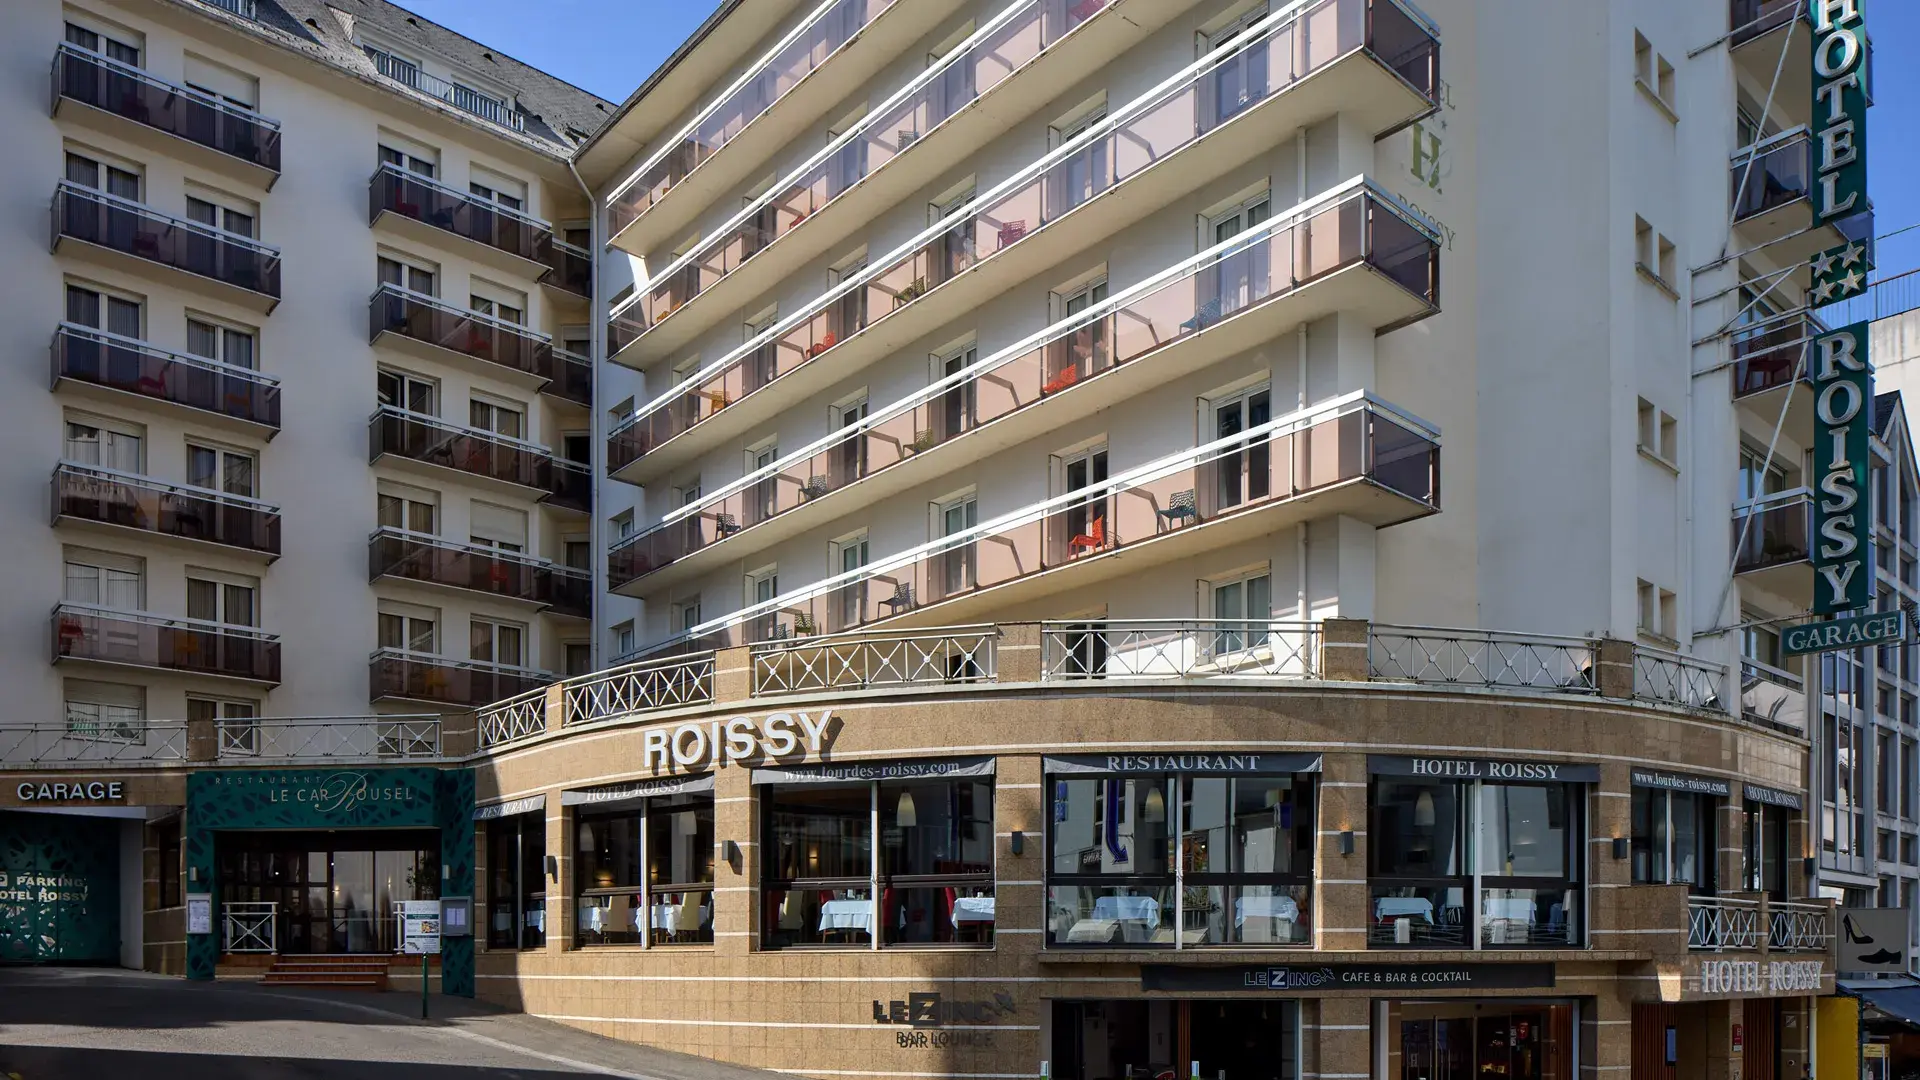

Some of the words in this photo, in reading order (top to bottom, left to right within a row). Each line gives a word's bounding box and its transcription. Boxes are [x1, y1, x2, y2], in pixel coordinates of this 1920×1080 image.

[1817, 331, 1865, 606] ROISSY
[1789, 615, 1899, 651] GARAGE
[644, 710, 833, 768] ROISSY
[784, 762, 960, 780] www.lourdes-roissy.com
[1106, 755, 1261, 772] RESTAURANT
[1411, 758, 1482, 777] HOTEL
[1488, 761, 1560, 780] ROISSY
[17, 781, 122, 801] GARAGE
[215, 776, 322, 785] RESTAURANT
[586, 784, 631, 803] HOTEL
[635, 777, 687, 796] ROISSY
[1634, 772, 1728, 793] www.lourdes-roissy.com
[271, 789, 289, 802] LE
[1749, 785, 1773, 802] HOTEL
[1774, 791, 1799, 808] ROISSY
[481, 797, 537, 819] RESTAURANT
[16, 876, 84, 887] PARKING
[0, 890, 34, 901] OTEL
[38, 891, 89, 902] ROISSY
[1342, 972, 1370, 982] CAFE
[1374, 972, 1381, 982] &
[1385, 972, 1407, 982] BAR
[1410, 972, 1417, 982] &
[1422, 971, 1472, 982] COCKTAIL
[1703, 960, 1761, 993] HOTEL
[1770, 960, 1824, 991] ROISSY
